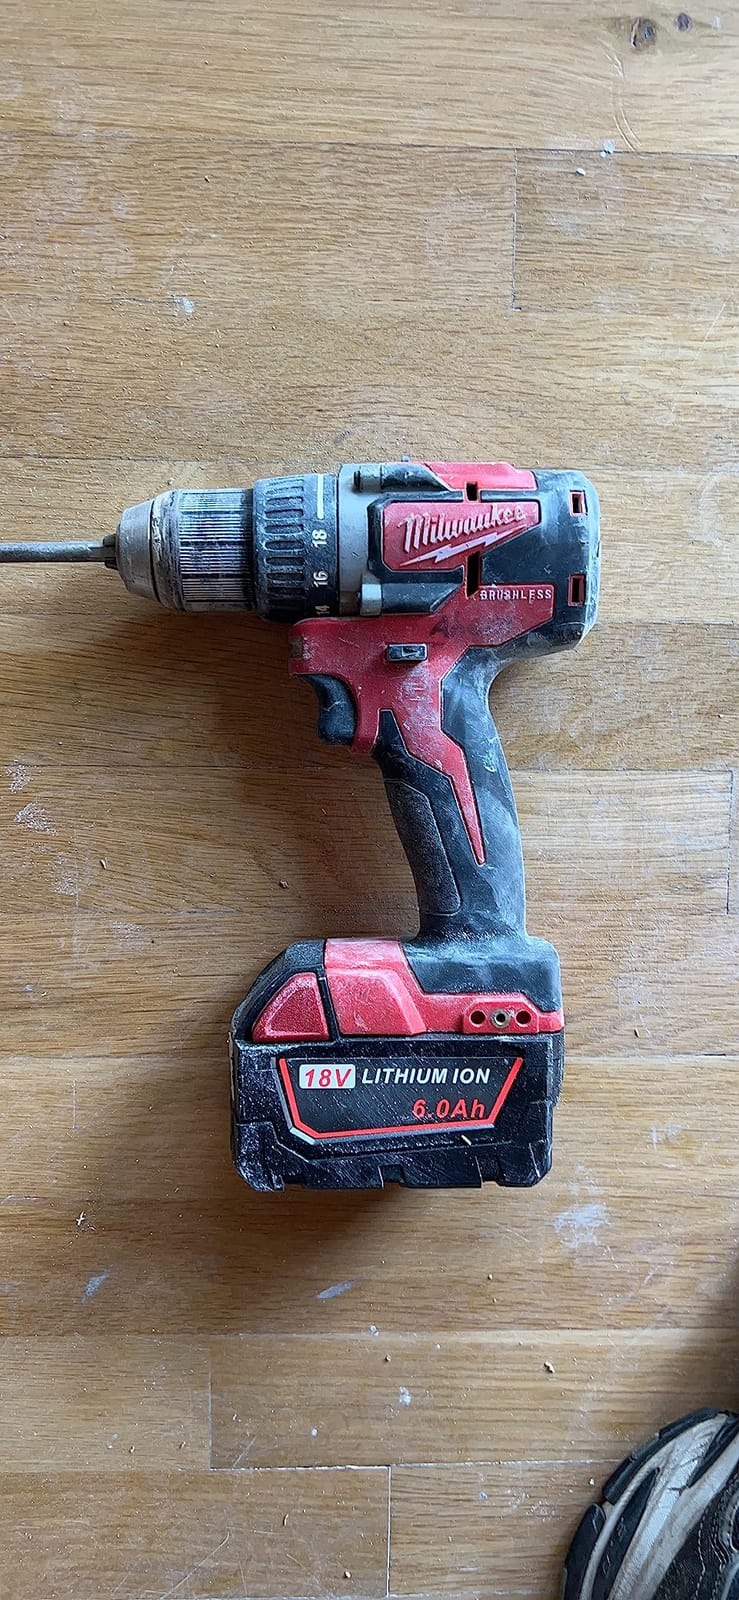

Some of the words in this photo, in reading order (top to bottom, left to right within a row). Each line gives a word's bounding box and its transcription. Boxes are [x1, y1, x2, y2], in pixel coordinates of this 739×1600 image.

[397, 503, 528, 553] Milwaukee
[311, 529, 328, 548] 18
[313, 570, 329, 588] 16
[479, 589, 552, 601] BRUSHLESS
[303, 1068, 353, 1088] 18V
[361, 1068, 448, 1084] LITHIUM
[452, 1068, 491, 1084] ION
[412, 1098, 486, 1119] 6.0Ah
